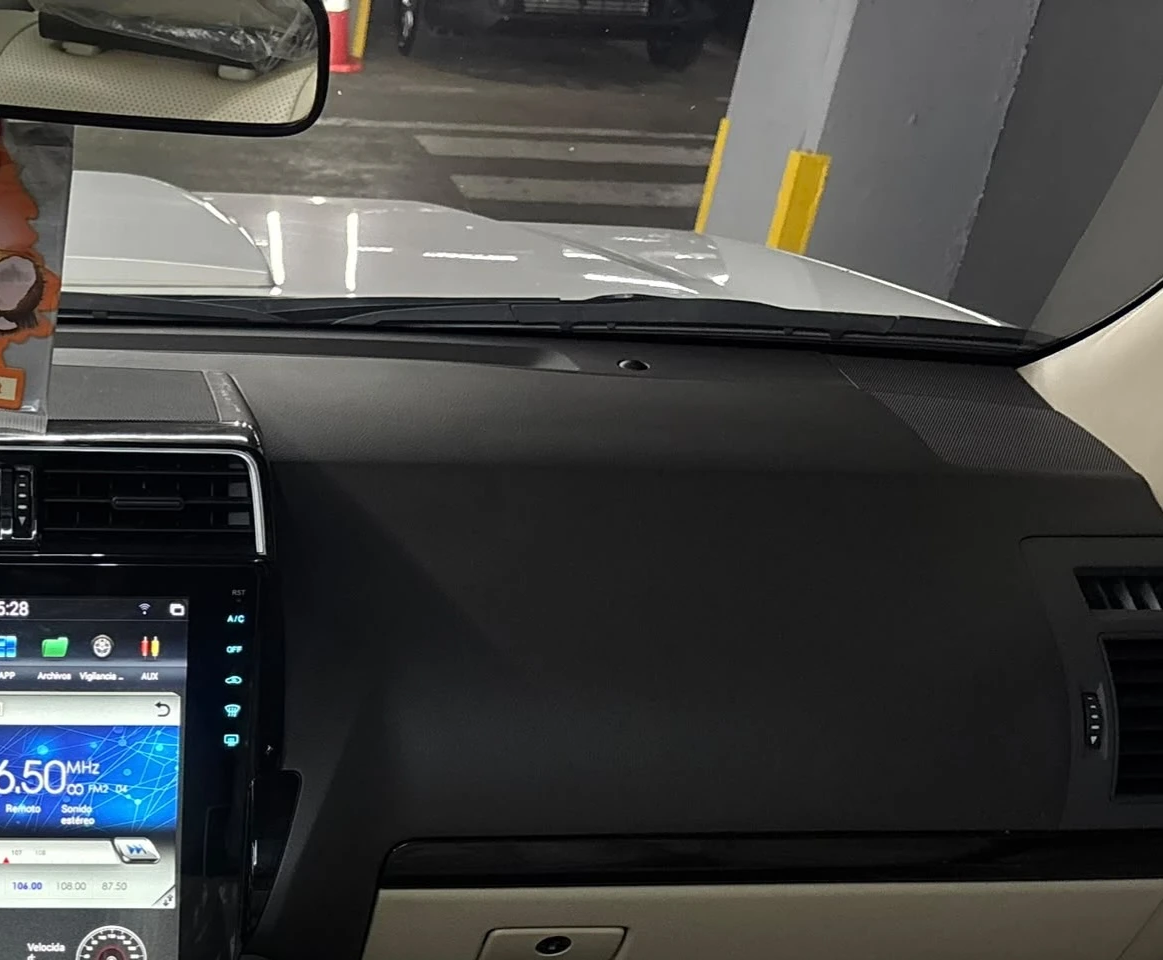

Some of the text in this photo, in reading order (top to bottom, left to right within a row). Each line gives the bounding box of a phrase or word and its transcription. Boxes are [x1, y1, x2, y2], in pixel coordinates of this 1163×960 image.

[227, 615, 245, 623] A/C
[226, 645, 243, 653] OFF
[37, 671, 72, 682] Archivos
[141, 673, 159, 682] AUX
[66, 761, 100, 775] MHz
[6, 804, 41, 815] Remoto
[61, 804, 93, 814] Sonido
[12, 881, 43, 891] 106.00
[56, 881, 87, 891] 108.00
[101, 881, 128, 891] 87.50
[27, 943, 65, 952] Velocida
